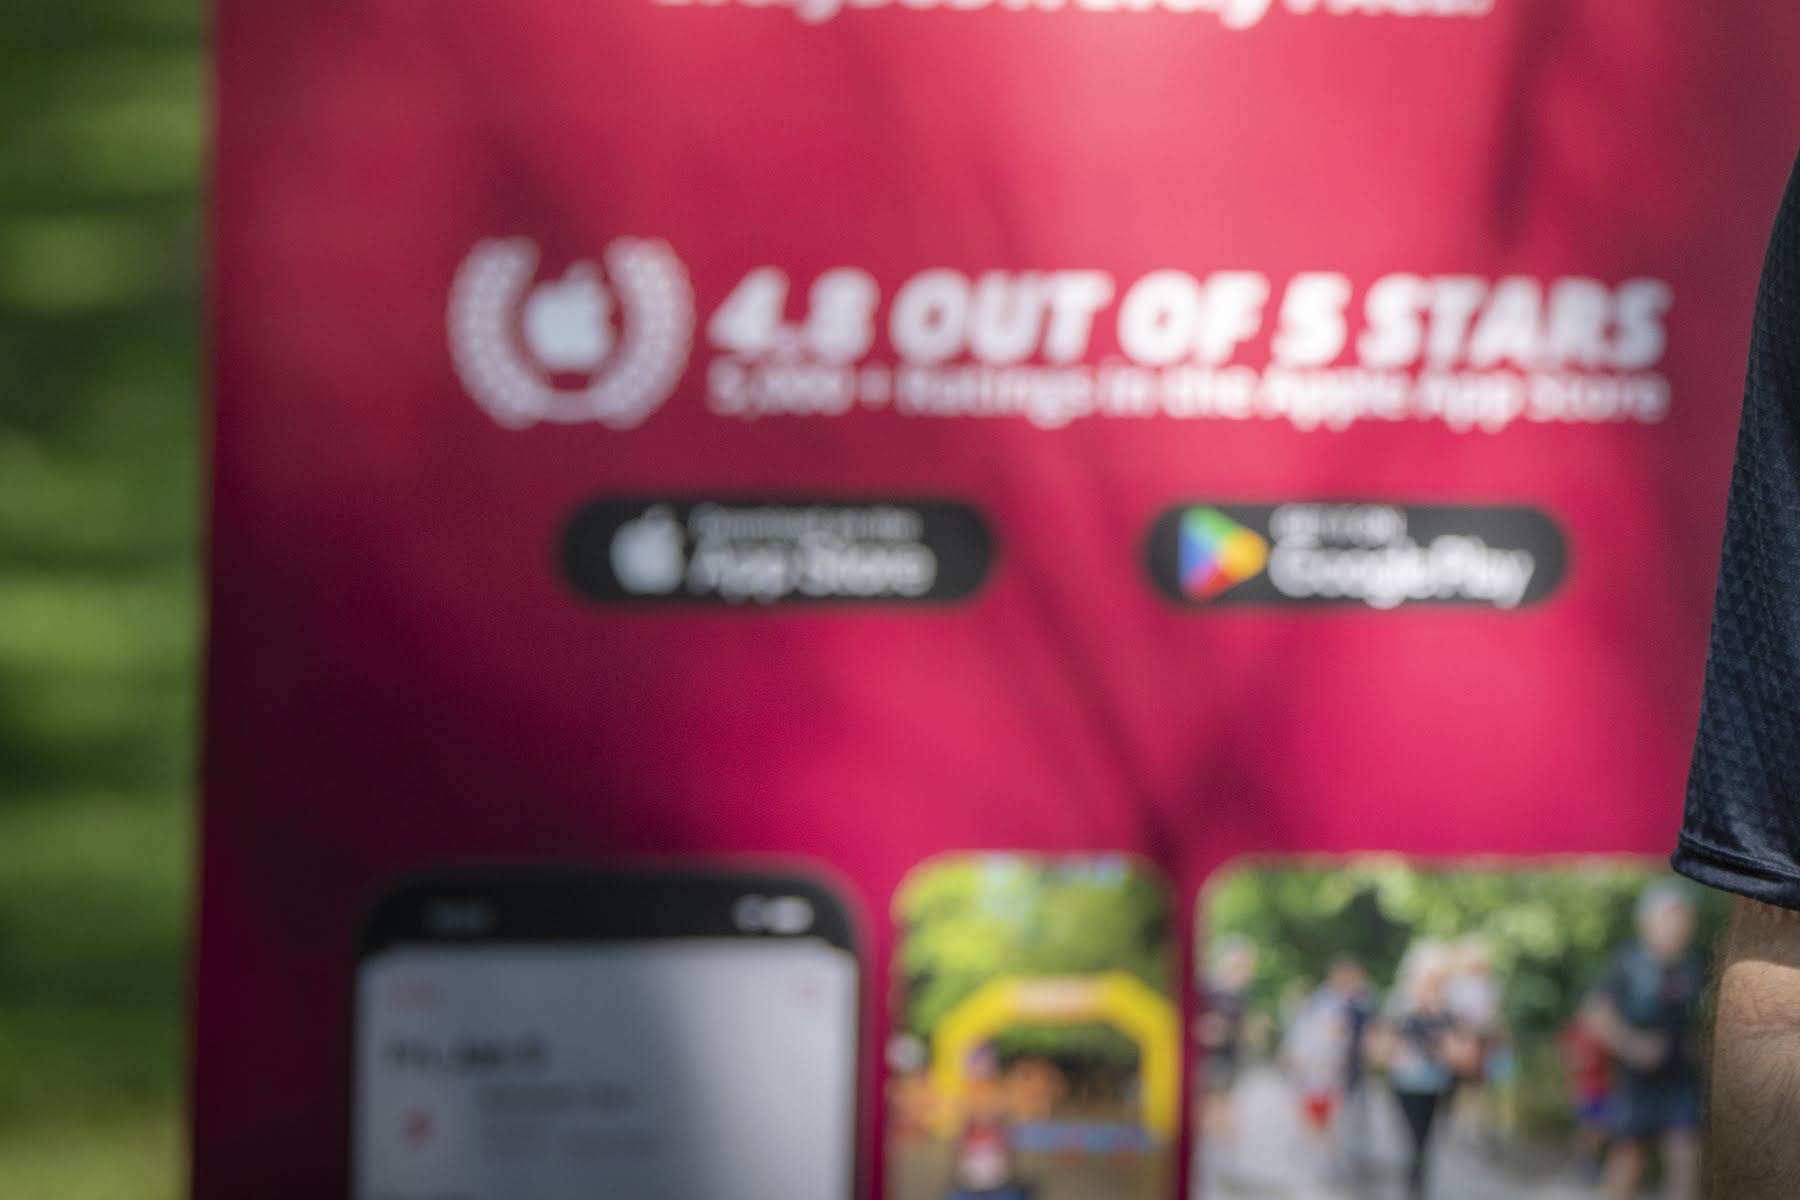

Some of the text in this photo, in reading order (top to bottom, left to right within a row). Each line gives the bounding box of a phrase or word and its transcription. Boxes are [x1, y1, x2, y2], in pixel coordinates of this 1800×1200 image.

[712, 271, 1669, 367] 4.8 OUT OF 5 STARS
[1164, 366, 1253, 413] the
[1261, 368, 1412, 425] Apple
[1417, 370, 1518, 427] App
[692, 537, 932, 597] App Store
[1273, 539, 1529, 604] Google Play
